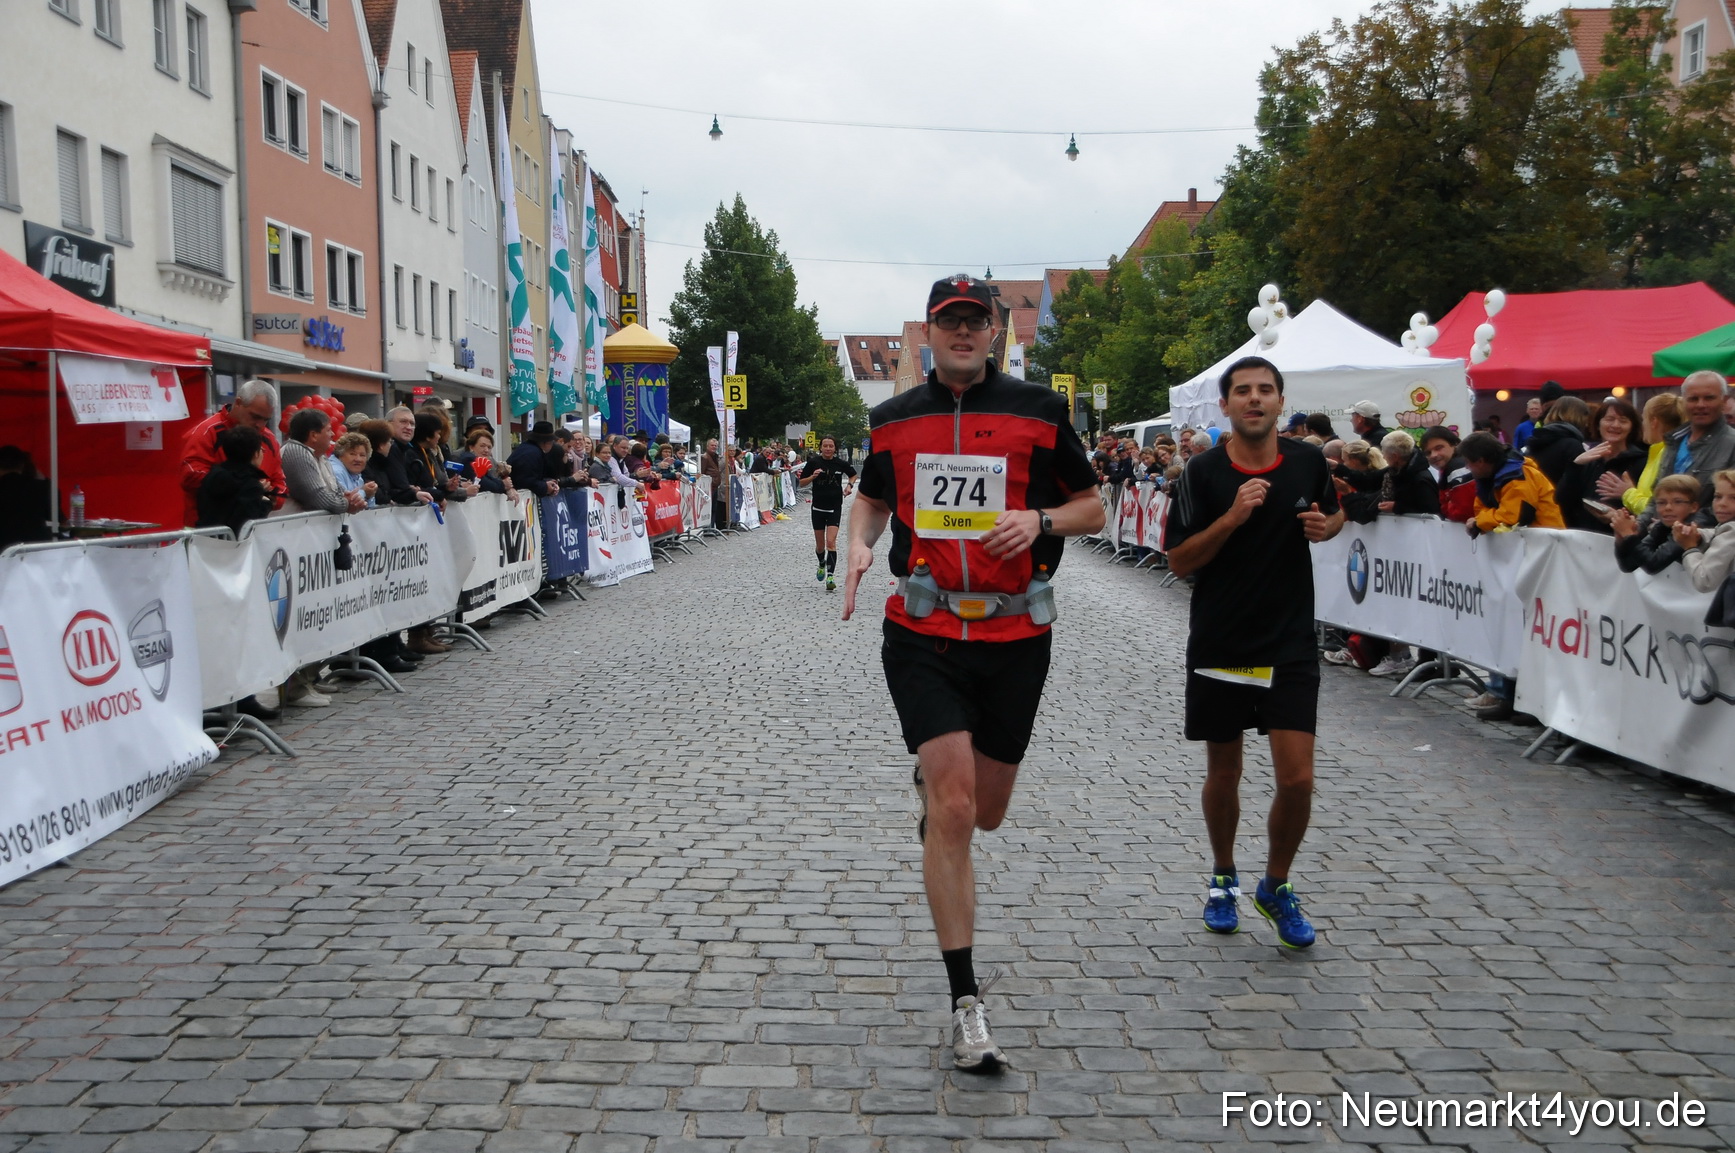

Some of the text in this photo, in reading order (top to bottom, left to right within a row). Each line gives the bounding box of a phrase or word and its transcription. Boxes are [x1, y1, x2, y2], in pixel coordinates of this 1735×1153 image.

[729, 385, 742, 402] B
[1054, 375, 1073, 383] Block
[916, 462, 989, 473] PARTL Neumarkt
[932, 475, 987, 507] 274
[943, 514, 972, 527] Sven
[298, 551, 332, 595] BMW
[1374, 557, 1484, 620] BMW Laufsport
[297, 602, 333, 632] Weniger
[72, 627, 117, 670] KIA
[1531, 597, 1668, 685] Audi BKK
[61, 687, 143, 734] KIA MOTORS
[0, 810, 61, 866] 9181/26
